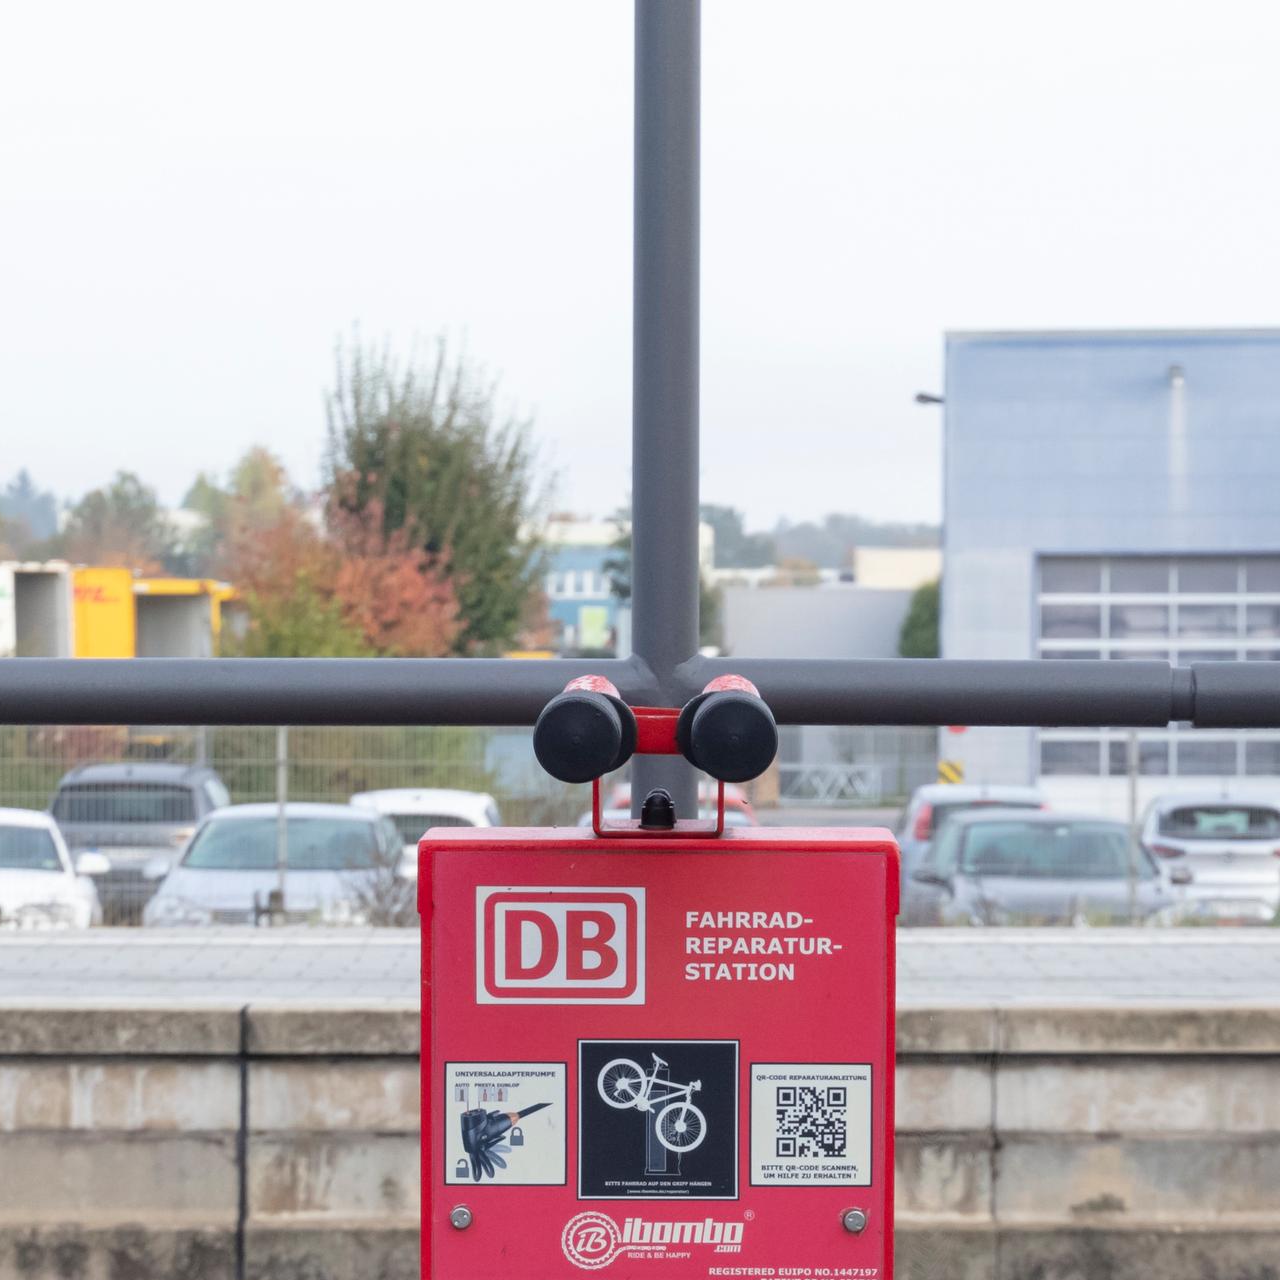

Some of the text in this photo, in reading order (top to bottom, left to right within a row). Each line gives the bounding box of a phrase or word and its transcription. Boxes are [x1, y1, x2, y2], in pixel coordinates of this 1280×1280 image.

[685, 911, 813, 928] FAHRRAD-
[505, 910, 618, 980] DB
[685, 937, 842, 954] REPARATUR-
[684, 963, 795, 981] STATION
[623, 1218, 744, 1243] ibombo
[714, 1245, 741, 1253] .com
[708, 1268, 878, 1276] REGISTERED EUIPO NO.1447197
